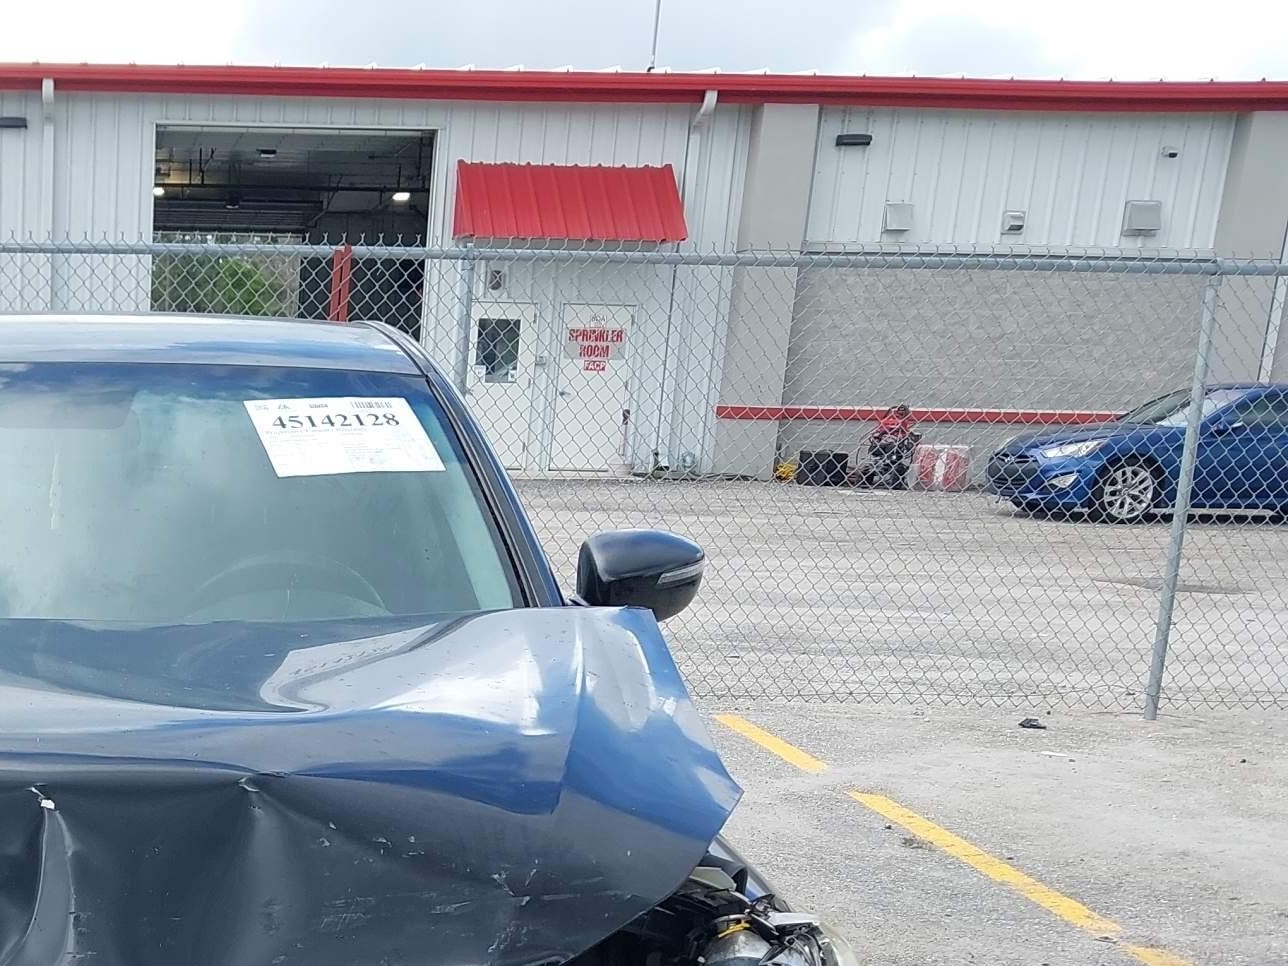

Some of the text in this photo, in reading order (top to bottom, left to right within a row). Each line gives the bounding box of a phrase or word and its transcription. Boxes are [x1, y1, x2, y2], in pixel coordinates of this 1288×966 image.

[568, 328, 624, 343] SPRINKLER
[579, 344, 610, 358] ROOM
[584, 360, 606, 371] FACP
[272, 412, 400, 429] 45142128
